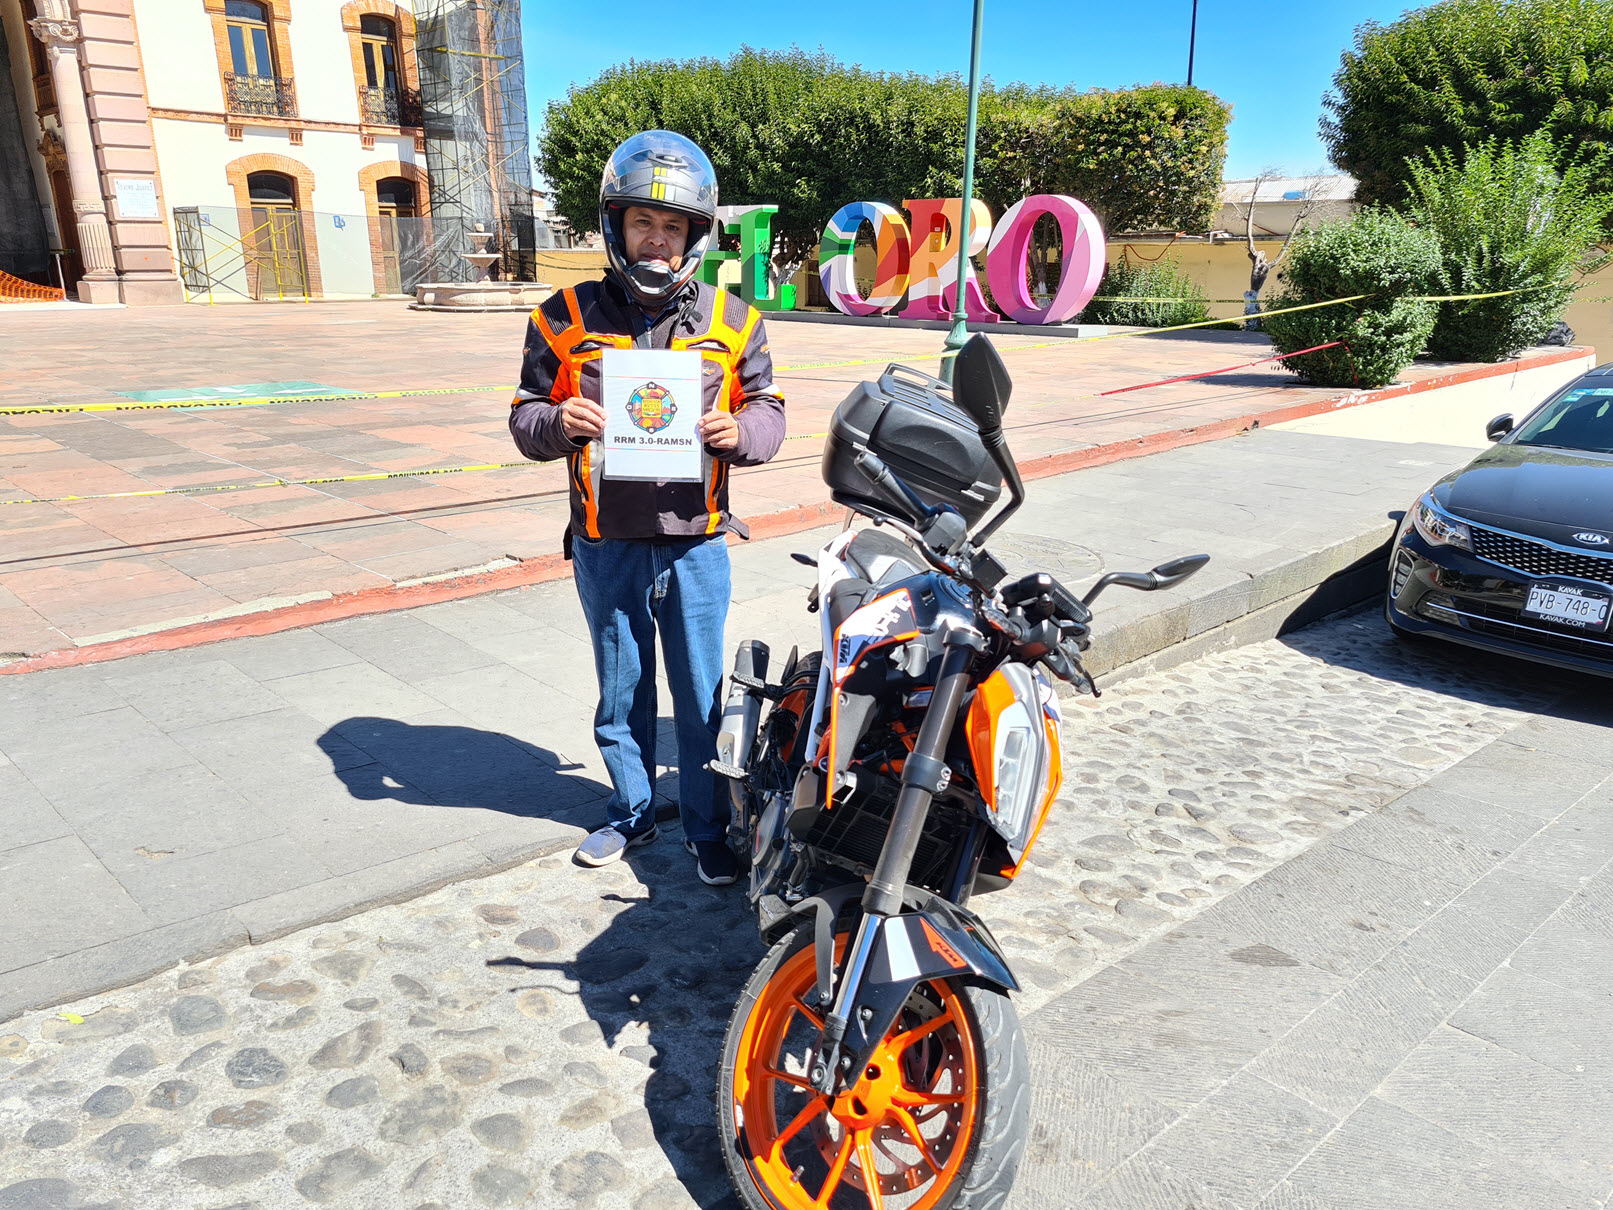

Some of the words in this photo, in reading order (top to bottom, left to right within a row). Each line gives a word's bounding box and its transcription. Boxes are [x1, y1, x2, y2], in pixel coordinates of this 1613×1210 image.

[819, 194, 1106, 325] ORO
[614, 436, 636, 444] RRM
[639, 437, 692, 446] 3.0-RAMSN
[1578, 533, 1601, 542] KIA
[1557, 585, 1584, 596] KAVAK
[1539, 613, 1586, 628] KAVAK.COM
[936, 941, 958, 963] KTM
